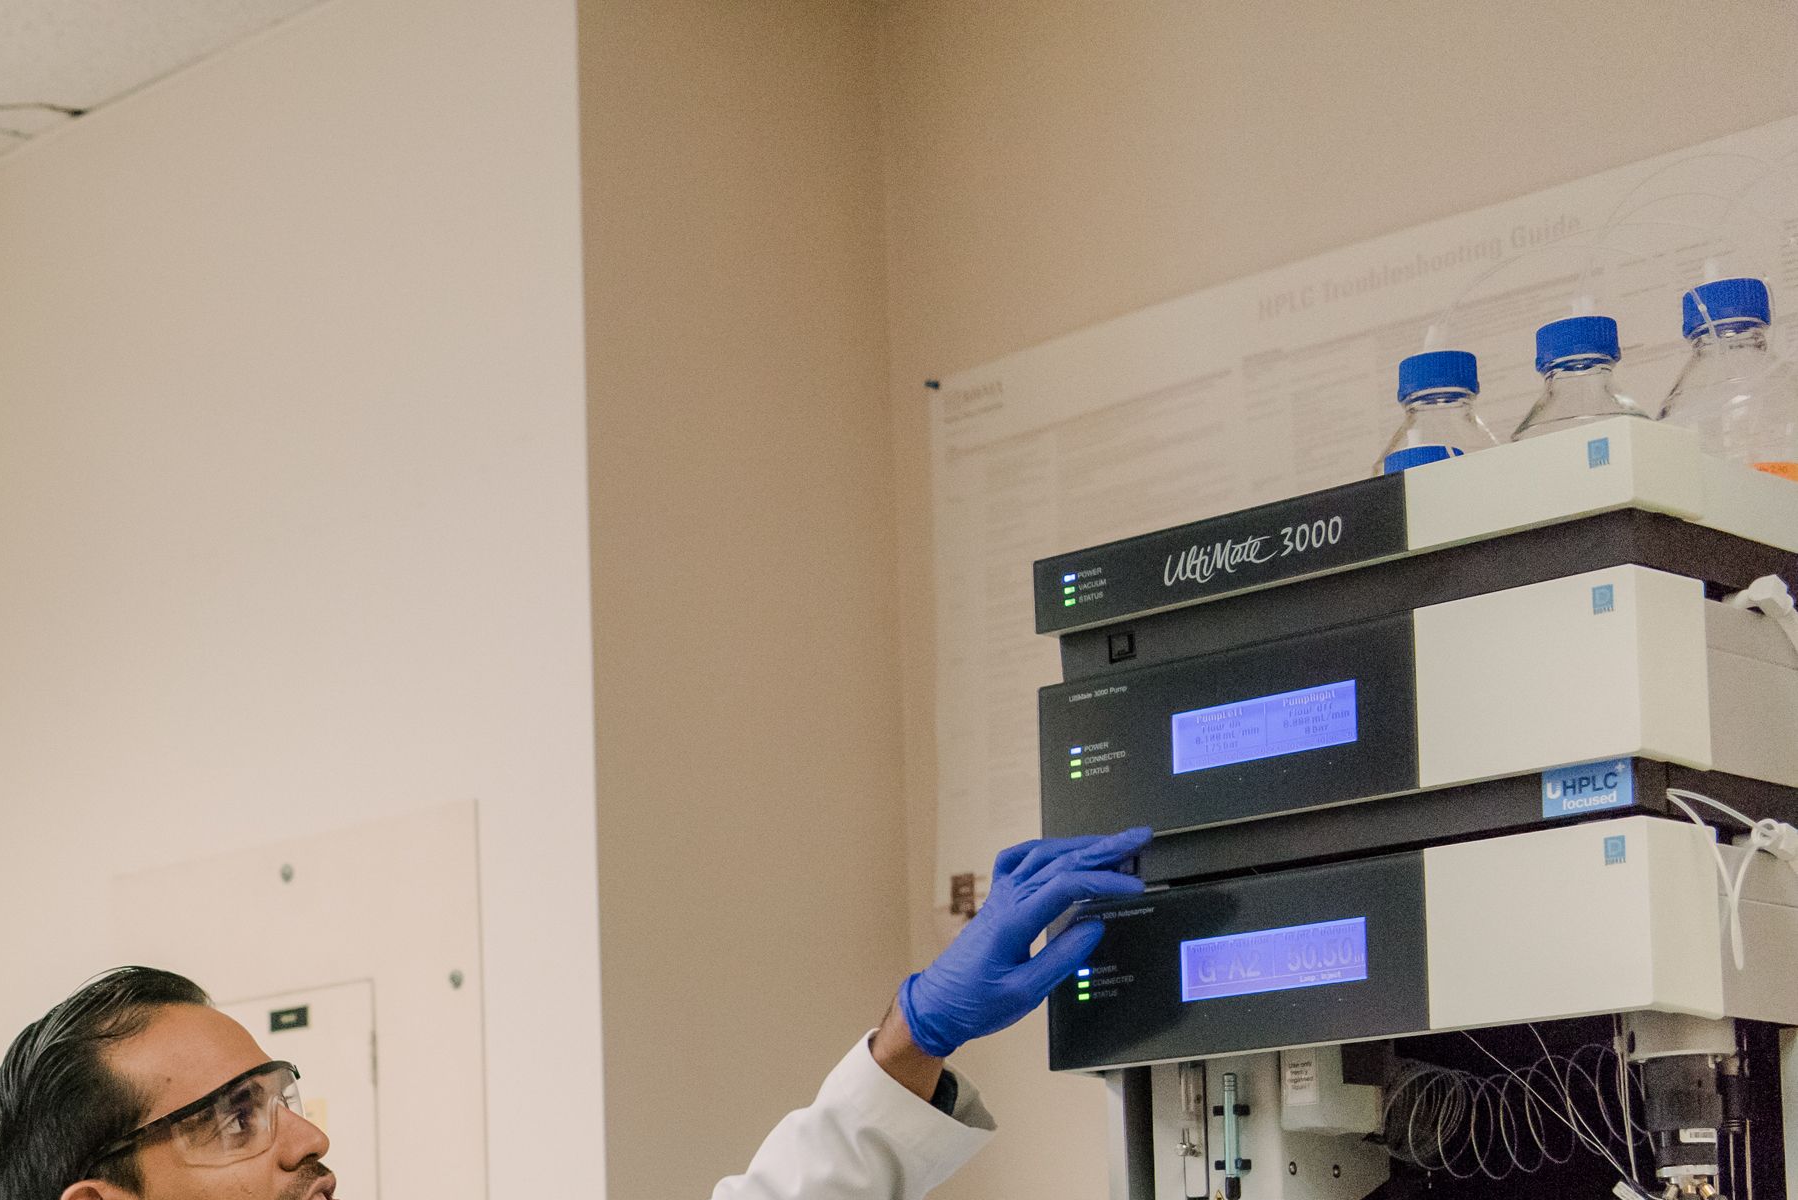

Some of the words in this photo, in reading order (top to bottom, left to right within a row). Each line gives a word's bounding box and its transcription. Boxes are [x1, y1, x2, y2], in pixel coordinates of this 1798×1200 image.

[1510, 213, 1581, 250] Guide
[1164, 535, 1278, 586] UltiMate
[1280, 516, 1343, 557] 3000
[1078, 567, 1102, 578] POWER
[1078, 579, 1107, 591] VACUUM
[1079, 591, 1103, 603] STATUS
[1084, 742, 1109, 753] POWER
[1084, 751, 1126, 764] CONNECTED
[1084, 766, 1110, 777] STATUS
[1562, 791, 1617, 811] focused
